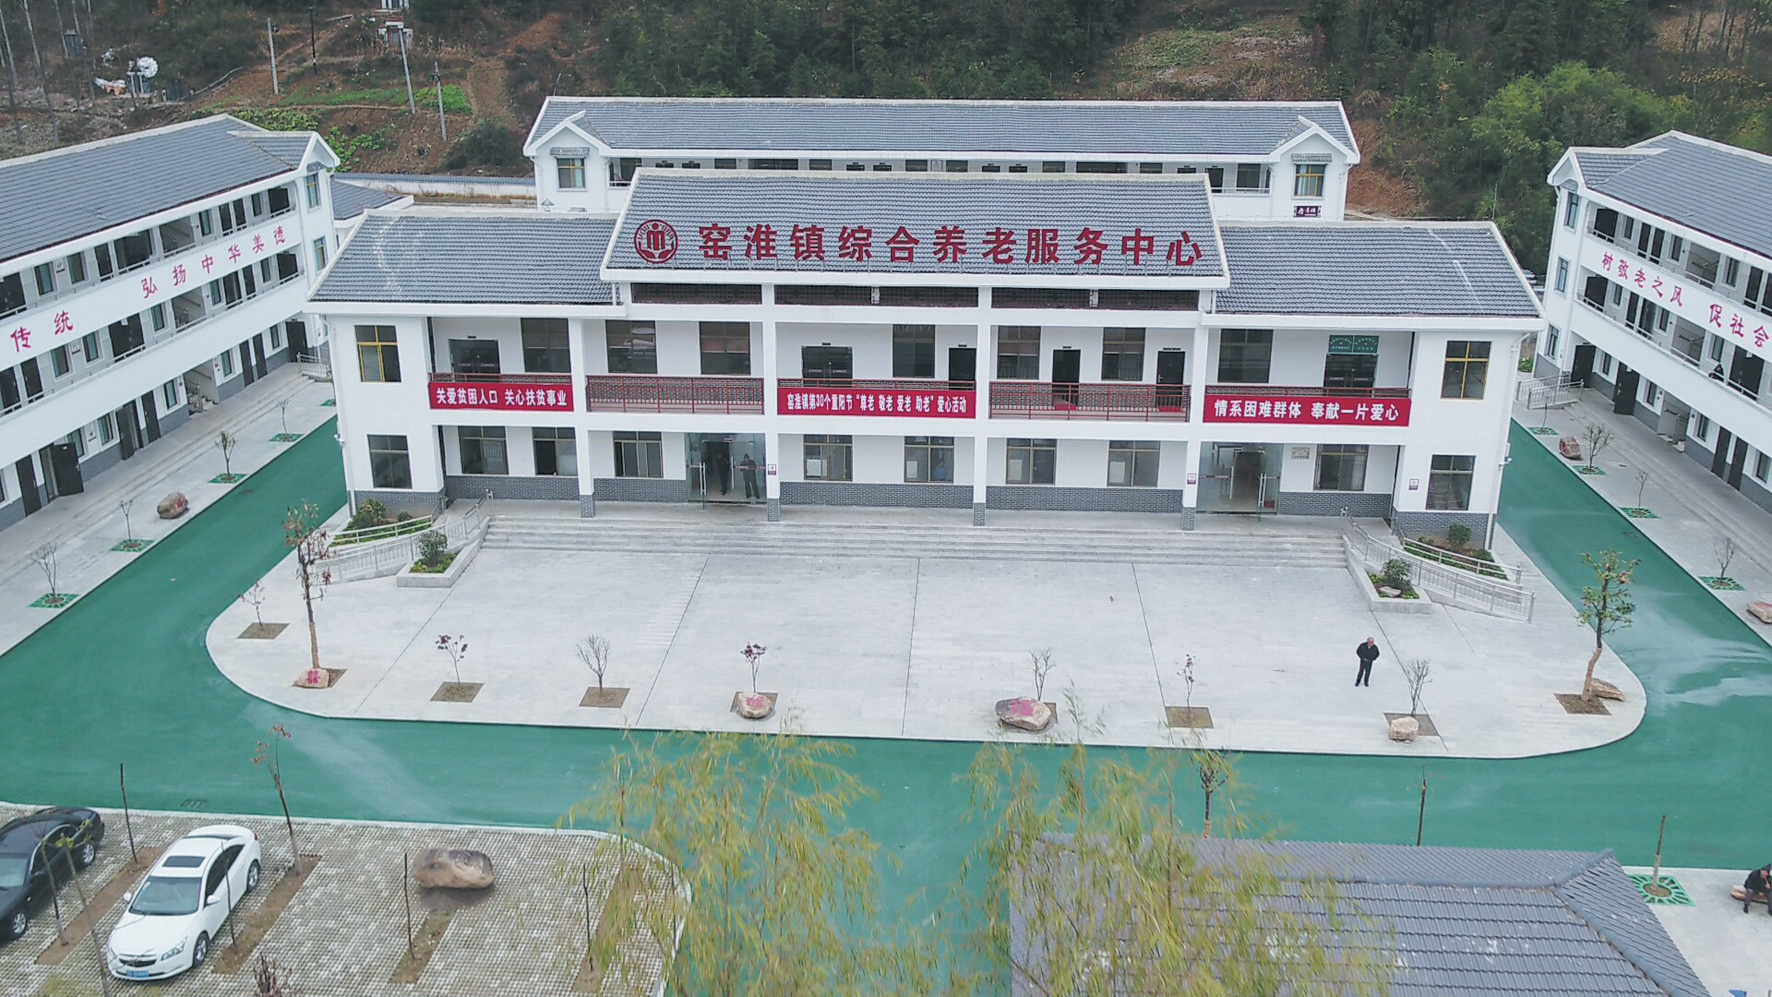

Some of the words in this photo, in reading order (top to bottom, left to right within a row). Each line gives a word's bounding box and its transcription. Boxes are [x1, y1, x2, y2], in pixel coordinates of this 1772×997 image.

[698, 223, 1204, 267] 窑淮镇综合养老服务中心
[10, 310, 74, 353] 传统
[141, 225, 286, 299] 弘扬中华美德
[1601, 251, 1683, 307] 树敬老之风
[1708, 303, 1770, 348] 促社会
[436, 387, 498, 405] 关爱贫困人口
[504, 388, 568, 406] 关心扶贫事业
[1214, 399, 1302, 419] 情系困难群体
[1310, 401, 1400, 421] 奉献一片爱心
